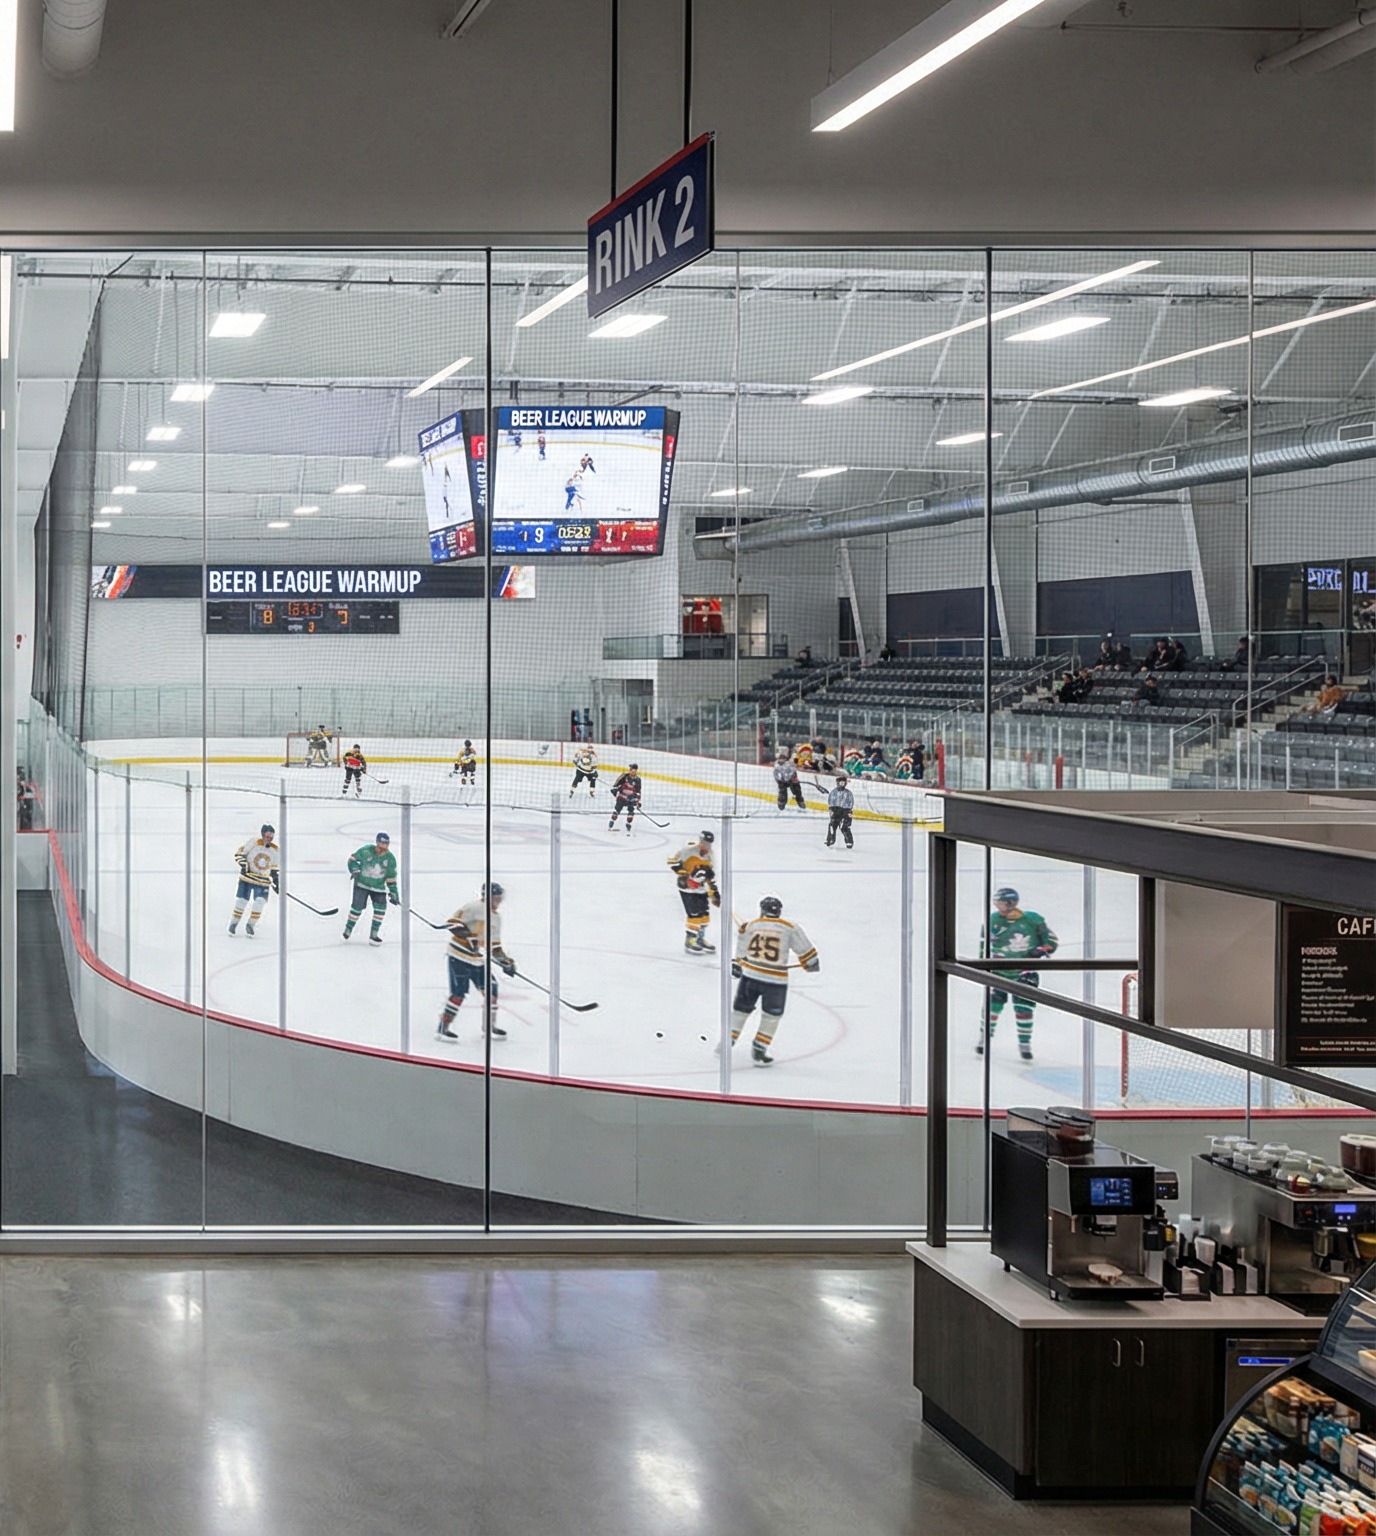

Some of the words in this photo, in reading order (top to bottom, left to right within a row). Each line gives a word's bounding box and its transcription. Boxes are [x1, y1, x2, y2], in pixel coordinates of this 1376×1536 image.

[595, 189, 667, 295] RINK
[674, 175, 695, 249] 2
[511, 410, 542, 426] BEER
[544, 410, 592, 426] LEAGUE
[594, 410, 647, 426] WARMUP
[209, 570, 257, 594] BEER
[262, 570, 333, 594] LEAGUE
[337, 570, 422, 594] WARMUP
[1337, 917, 1376, 936] CAF
[747, 933, 781, 962] 45
